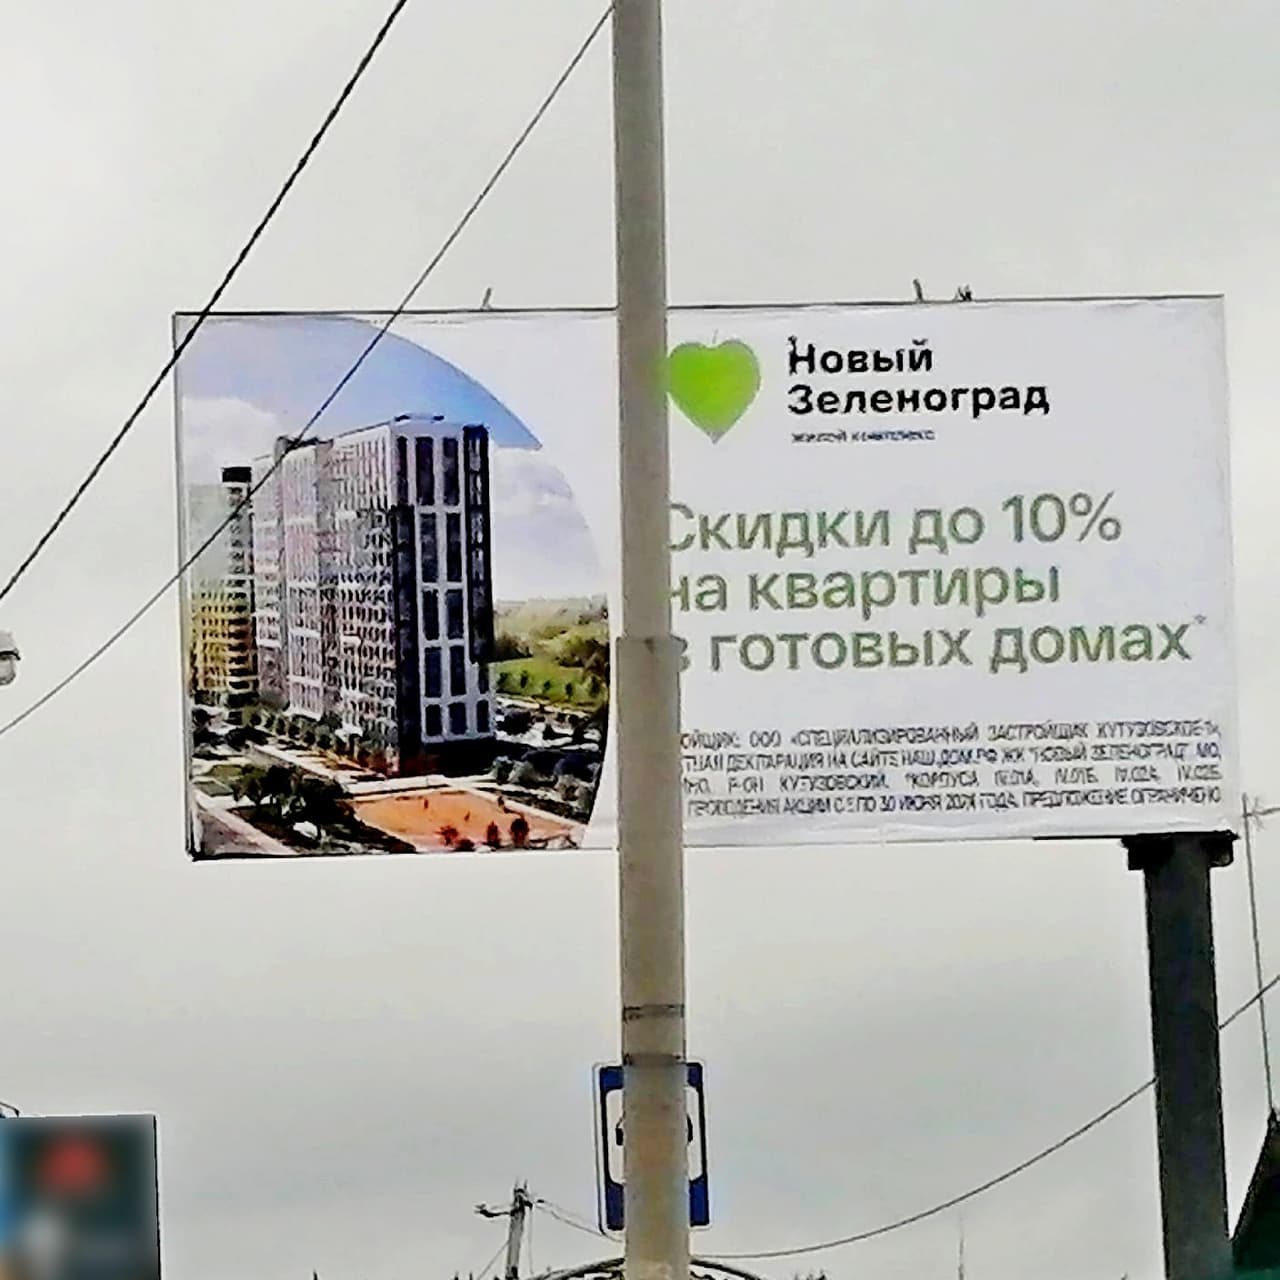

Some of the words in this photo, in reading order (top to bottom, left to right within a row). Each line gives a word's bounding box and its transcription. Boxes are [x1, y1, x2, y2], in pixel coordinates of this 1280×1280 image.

[788, 336, 933, 375] Новый
[788, 384, 1050, 418] Зеленоград
[670, 503, 890, 558] Скидки
[909, 507, 985, 555] до
[1002, 491, 1122, 543] 10%
[748, 565, 1059, 620] квартиры
[710, 628, 973, 672] готовых
